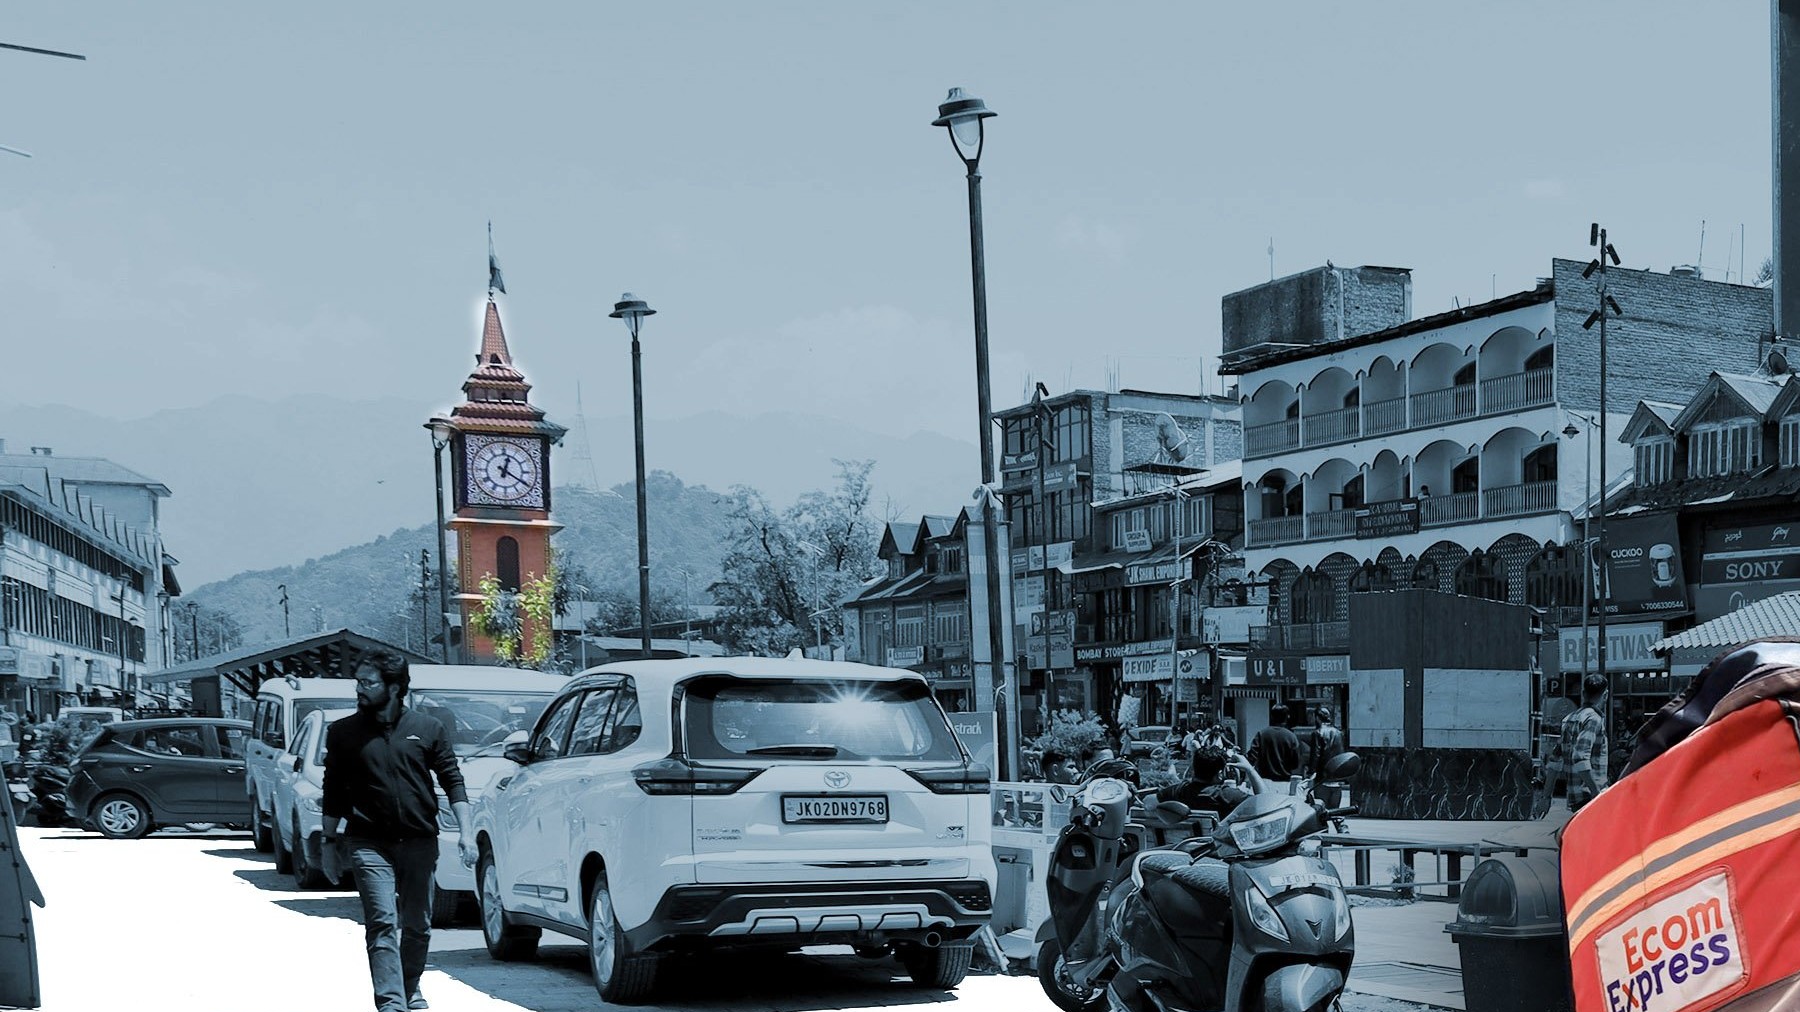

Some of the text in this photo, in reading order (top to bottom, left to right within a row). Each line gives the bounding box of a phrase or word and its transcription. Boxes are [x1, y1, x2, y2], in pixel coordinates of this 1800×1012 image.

[1611, 547, 1643, 559] CUCKOO
[1725, 560, 1784, 580] SONY
[1077, 648, 1102, 660] BOMBAY
[1131, 659, 1158, 675] EXIDE
[1254, 659, 1284, 677] U & I
[1308, 659, 1344, 672] LIBERTY
[1551, 680, 1559, 693] P
[796, 801, 885, 816] JK02DN9768
[1621, 897, 1723, 975] Ecom
